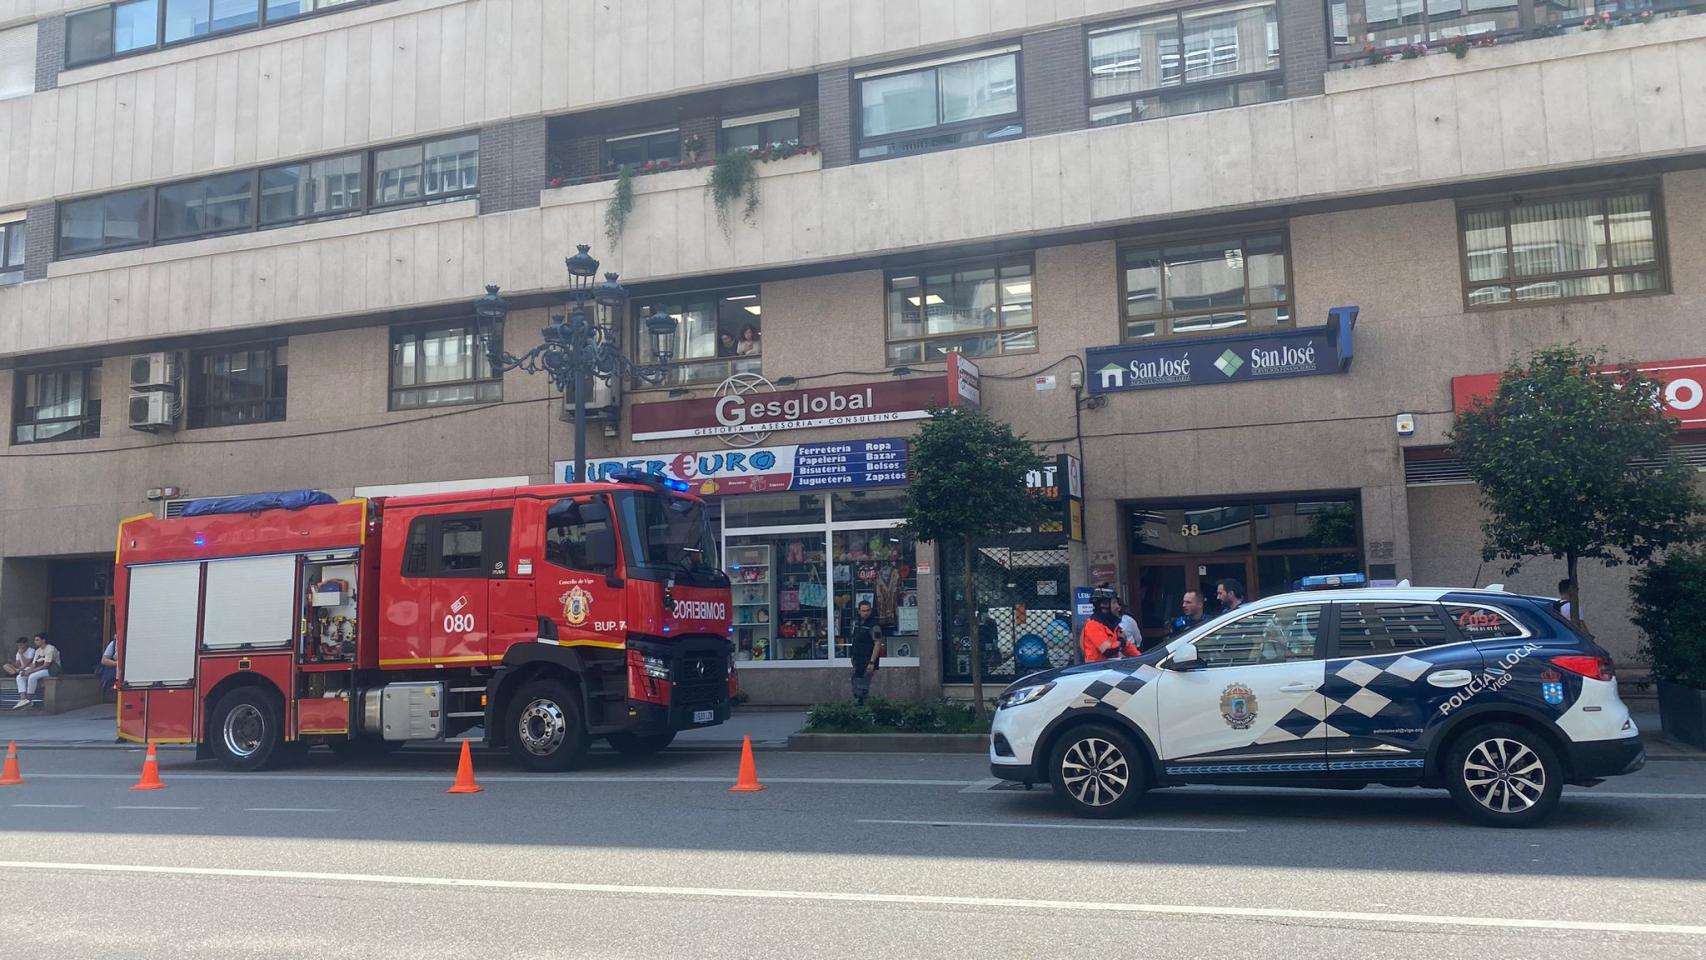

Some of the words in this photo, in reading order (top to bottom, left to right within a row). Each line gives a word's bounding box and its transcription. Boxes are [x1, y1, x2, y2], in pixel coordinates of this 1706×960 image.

[715, 388, 873, 428] Gesglobal
[828, 412, 900, 426] CONSULTING
[865, 443, 892, 451] Ropa
[866, 462, 900, 471] Bolsos
[865, 472, 907, 482] Zapatos
[1182, 524, 1199, 536] 58
[444, 613, 475, 633] 080
[1469, 613, 1499, 626] 092
[594, 621, 618, 632] BUP.
[1498, 642, 1543, 670] LOCAL
[1488, 673, 1513, 692] VIGO
